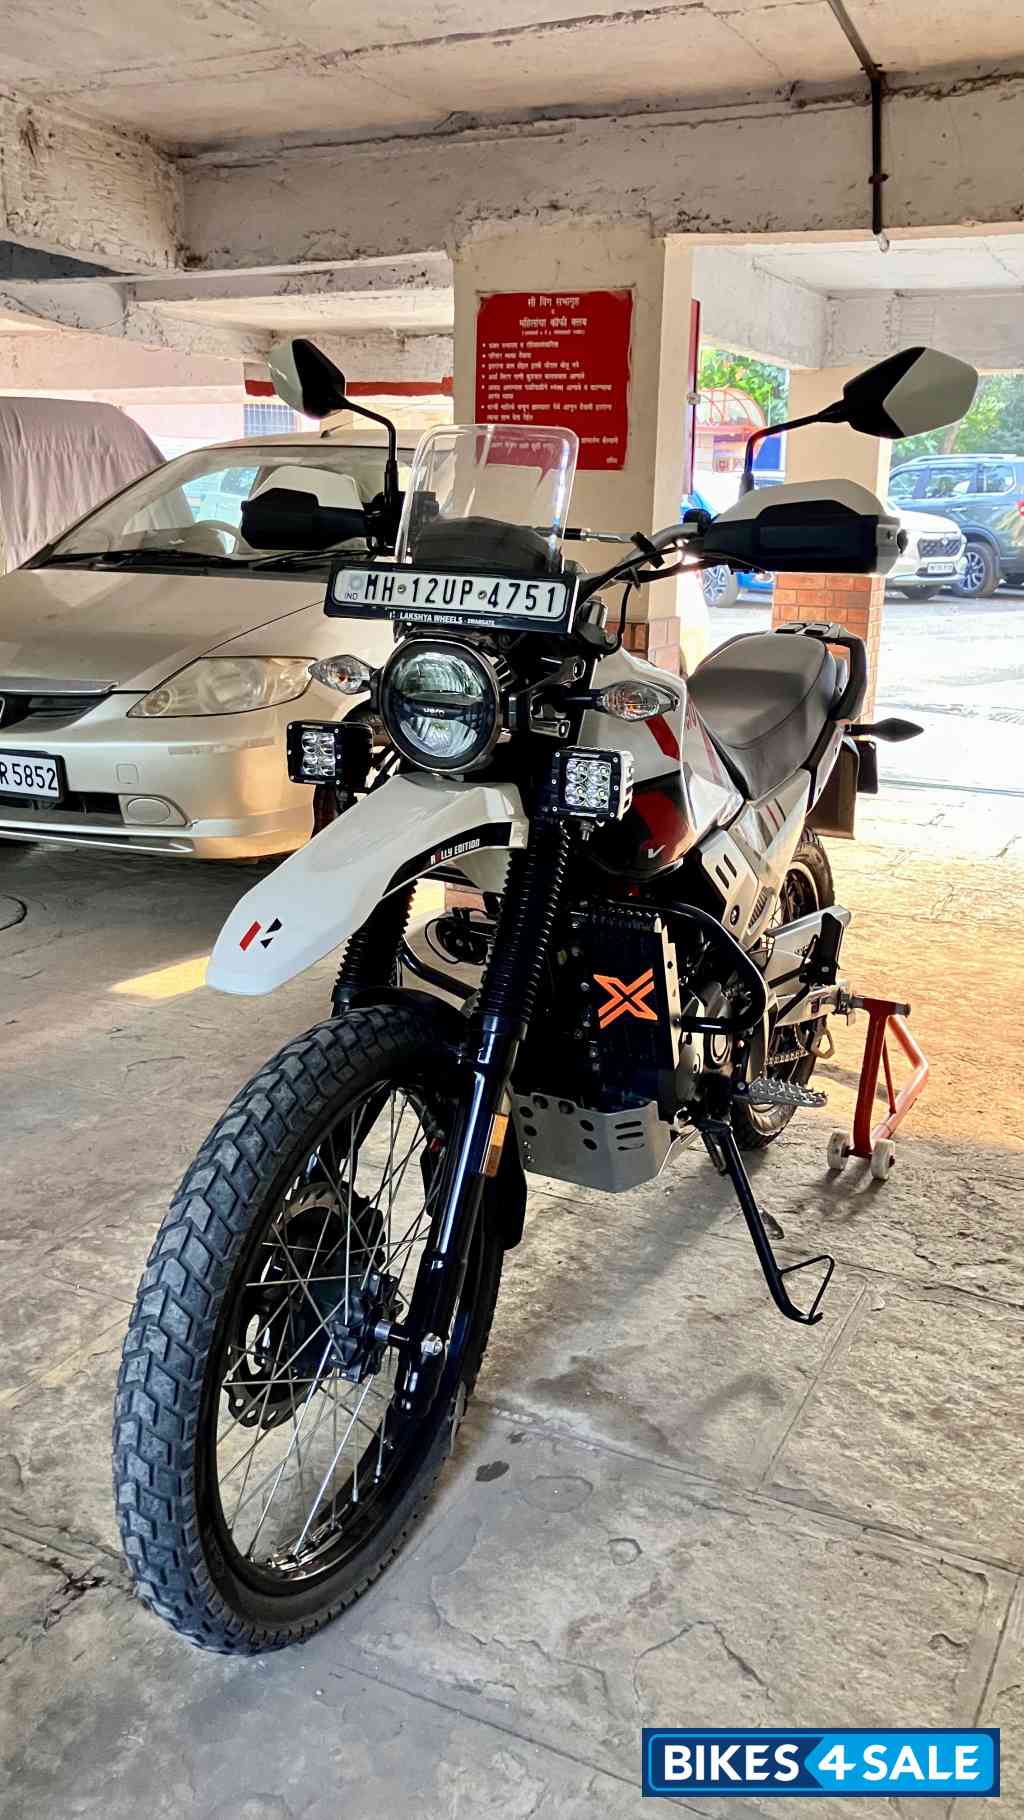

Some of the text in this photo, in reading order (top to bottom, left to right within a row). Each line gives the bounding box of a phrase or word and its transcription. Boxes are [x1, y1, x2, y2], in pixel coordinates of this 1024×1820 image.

[400, 611, 432, 623] LAKSHYA
[433, 614, 463, 624] WHEELS
[454, 838, 480, 855] EDITION
